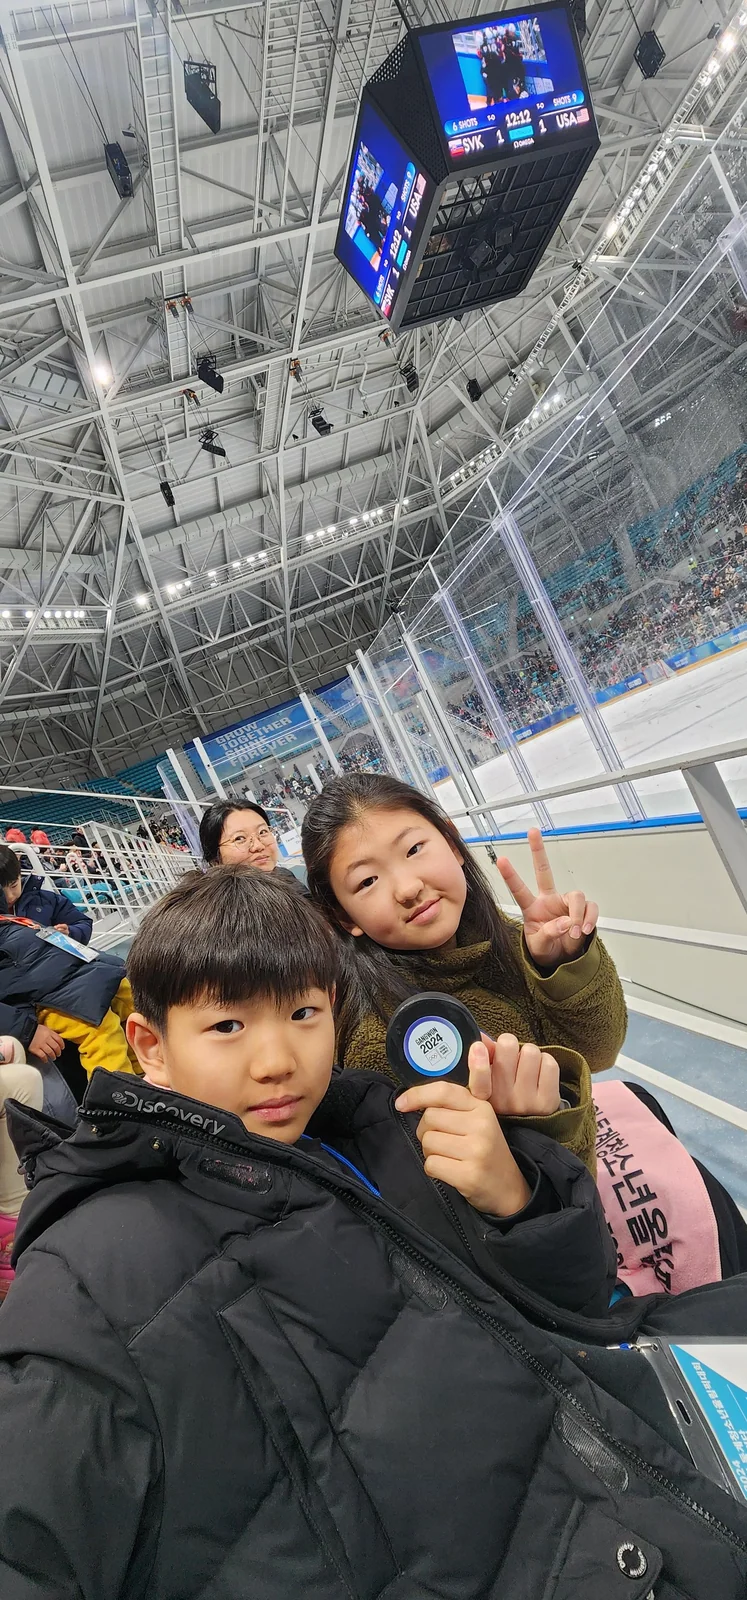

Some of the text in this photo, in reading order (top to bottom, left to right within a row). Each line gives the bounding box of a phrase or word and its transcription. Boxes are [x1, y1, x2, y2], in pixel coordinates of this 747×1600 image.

[553, 95, 577, 107] SHOTS 9
[452, 118, 478, 132] 6 SHOTS
[505, 110, 531, 127] 12:12
[539, 119, 547, 134] 1
[556, 112, 578, 128] USA
[462, 135, 485, 152] SVK
[496, 129, 505, 144] 1
[401, 180, 410, 202] SHOTS
[408, 192, 423, 218] USA
[404, 225, 412, 238] 1
[389, 230, 401, 260] 12:12
[392, 267, 400, 279] 1
[385, 284, 395, 306] SVK
[215, 721, 258, 744] GROW
[219, 717, 292, 751] TOGETHER
[230, 733, 298, 767] FOREVER
[415, 1027, 438, 1045] GANGWON
[420, 1033, 444, 1054] 2024
[121, 1091, 225, 1135] Discovery
